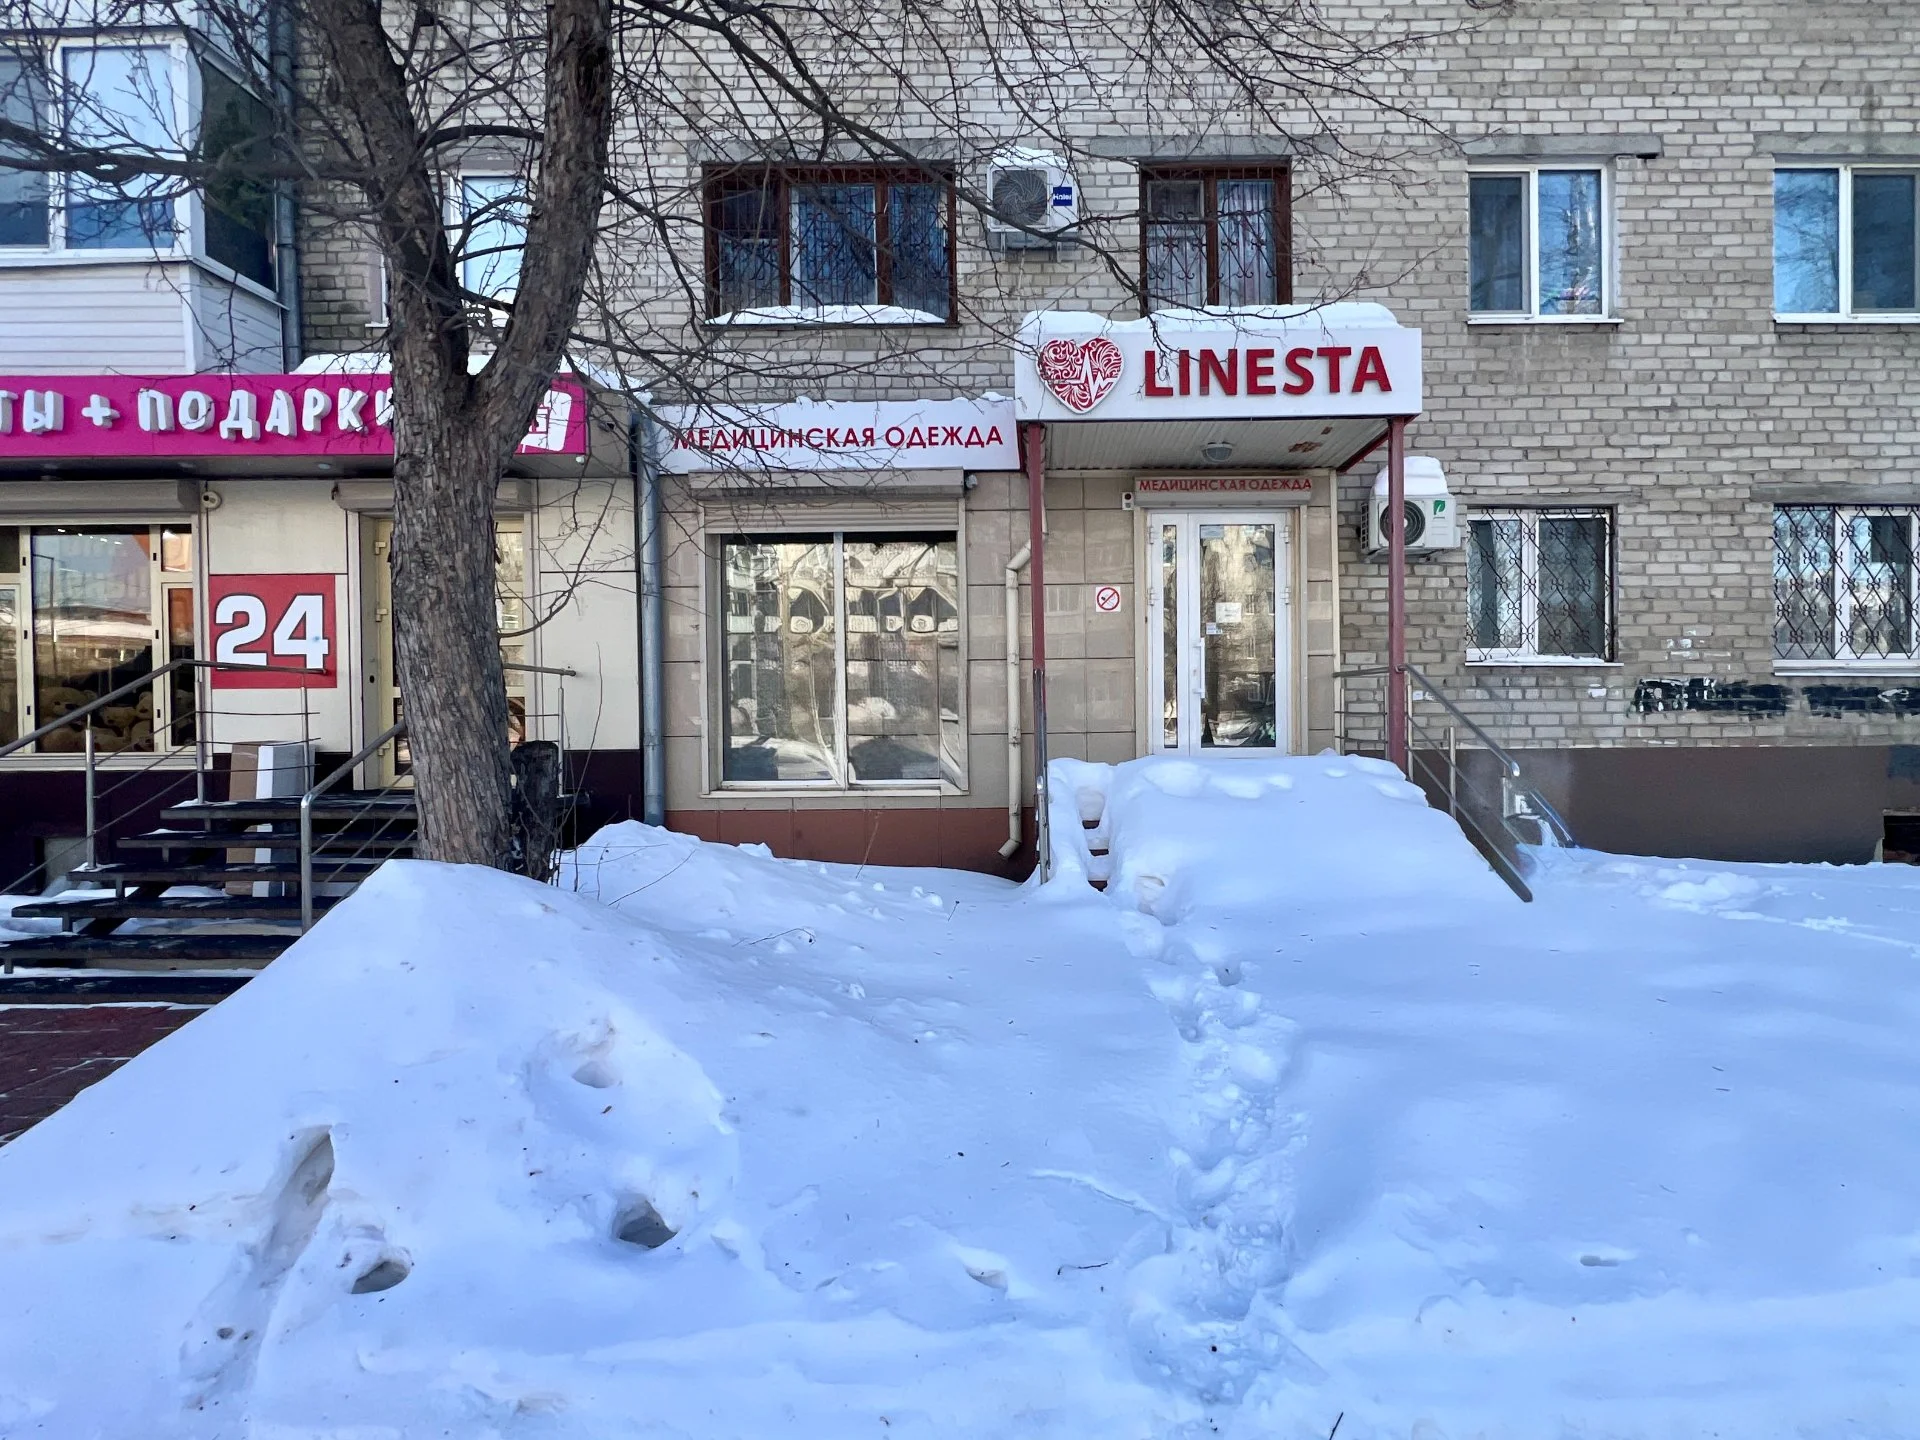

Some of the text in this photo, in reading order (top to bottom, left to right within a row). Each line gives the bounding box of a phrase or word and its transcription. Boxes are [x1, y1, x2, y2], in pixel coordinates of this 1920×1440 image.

[1145, 346, 1392, 396] LINESTA
[674, 426, 1003, 451] МЕДИЦИНСКАЯ ОДЕЖДА
[1139, 479, 1311, 492] МЕДИЦИНСКАЯ ОДЕЖДА
[215, 593, 328, 669] 24
